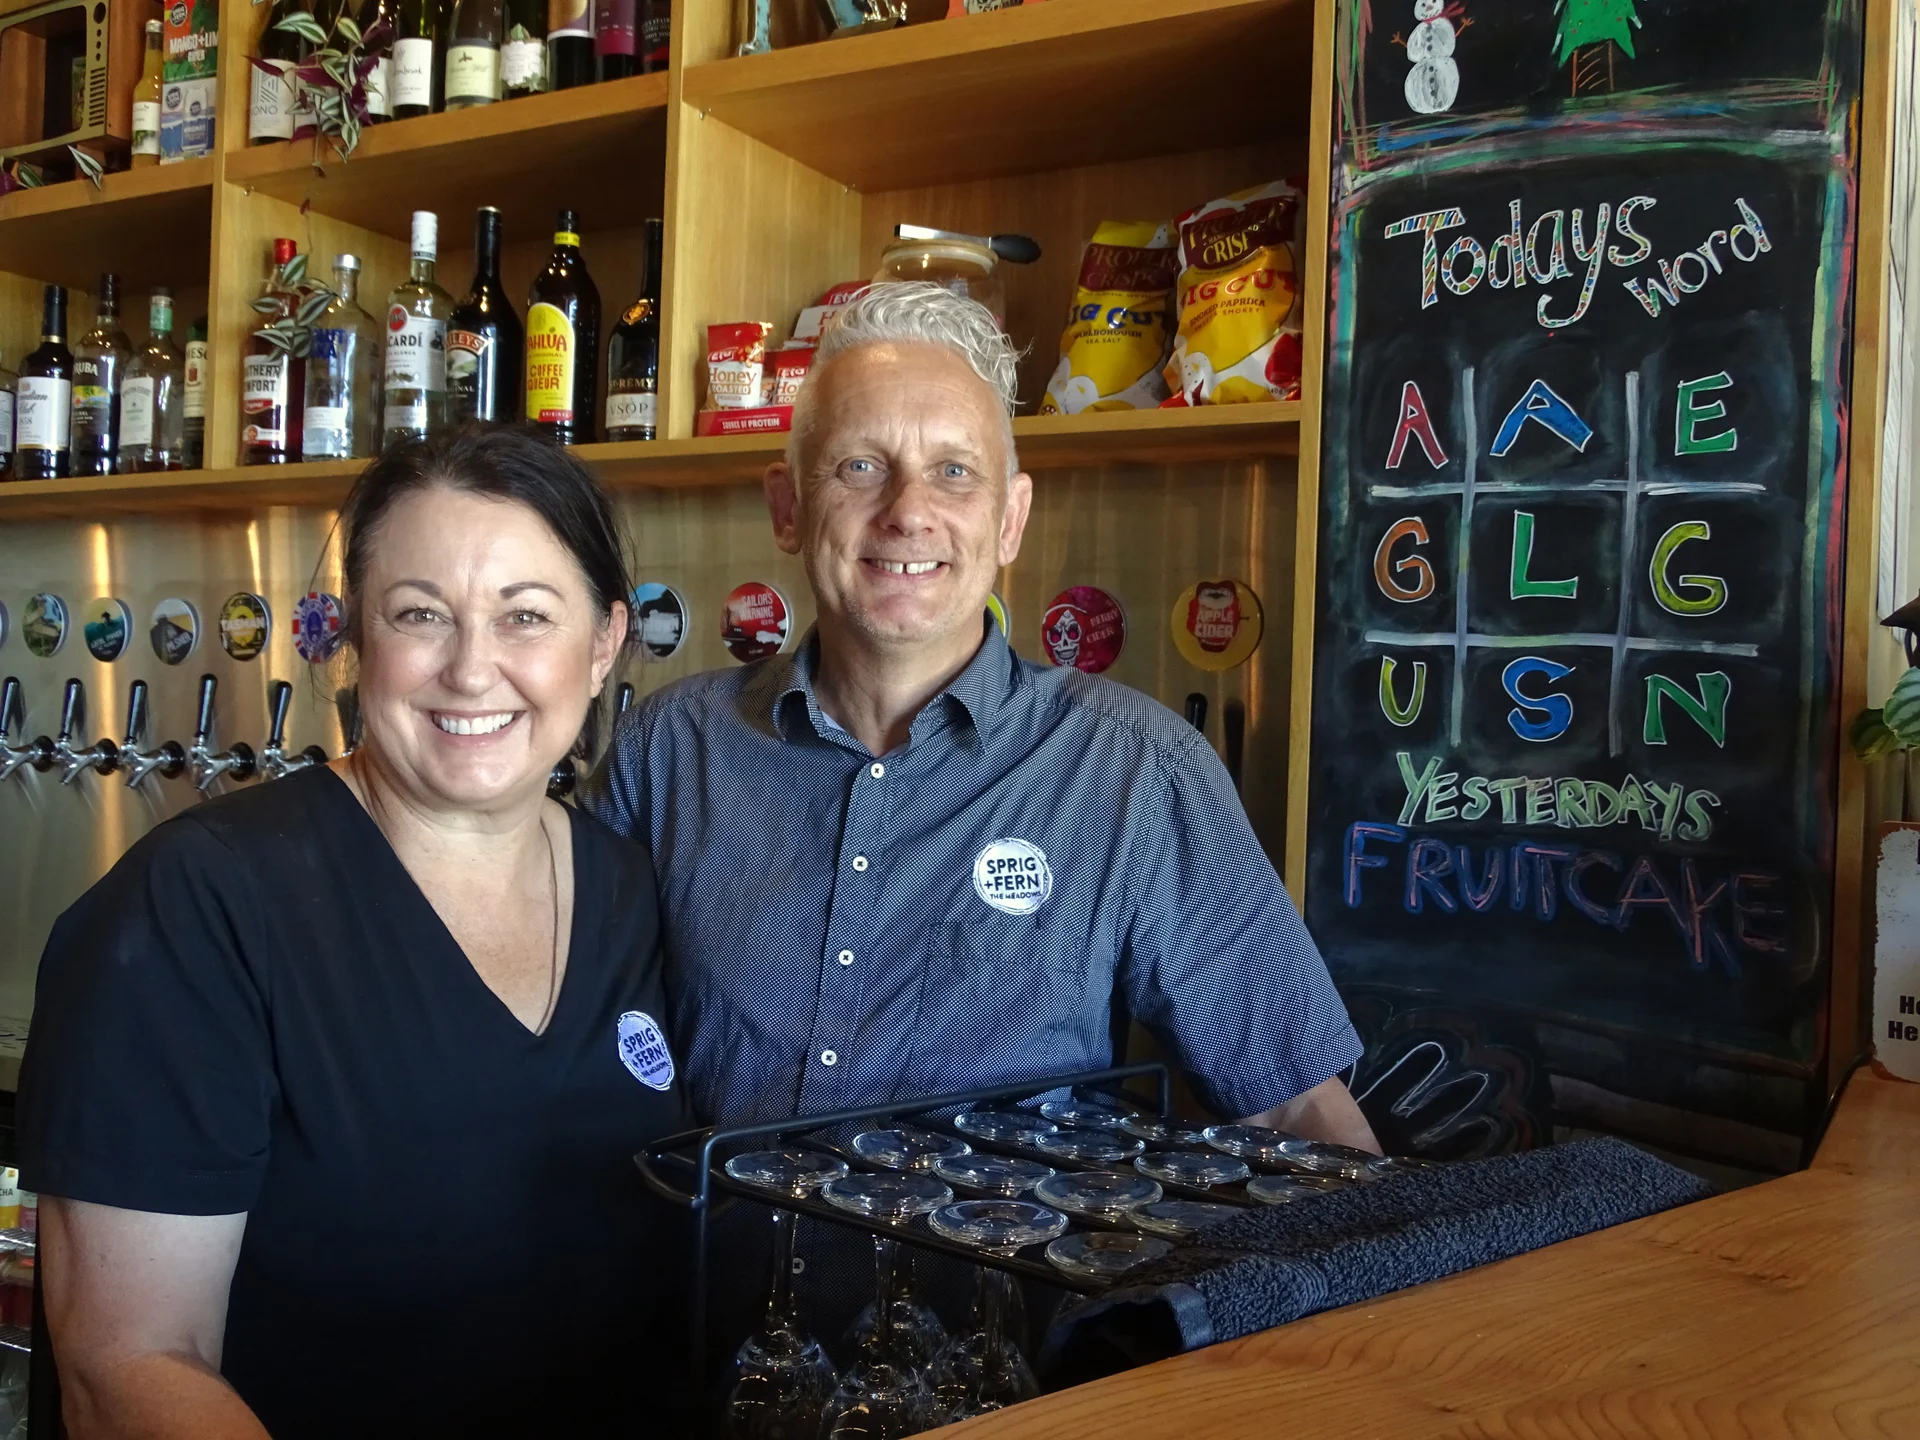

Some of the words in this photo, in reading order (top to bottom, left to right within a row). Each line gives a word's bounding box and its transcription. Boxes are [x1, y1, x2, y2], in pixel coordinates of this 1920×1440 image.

[1384, 195, 1657, 329] Todays
[1220, 297, 1266, 309] PAPRIKA
[530, 364, 564, 378] COFFEE
[709, 367, 758, 386] Honey
[711, 385, 750, 395] ROASTED
[748, 417, 781, 428] PROTEIN
[1385, 380, 1449, 470] A
[1674, 370, 1738, 457] E
[1373, 516, 1436, 604] G
[1510, 510, 1579, 600] L
[1648, 520, 1729, 618] G
[741, 593, 773, 607] SAILORS
[1090, 607, 1119, 627] BERRY
[1086, 626, 1115, 644] CIDER
[1195, 622, 1235, 638] CIDER
[1378, 654, 1427, 728] U
[1501, 655, 1577, 743] S
[1643, 670, 1732, 749] N
[1395, 752, 1722, 842] YESTERDAYS
[986, 857, 1037, 875] SPRIG
[989, 892, 1004, 900] THE
[1005, 890, 1043, 900] MEADOWS
[1343, 820, 1790, 979] FRUITCAKE
[623, 1027, 657, 1054] SPRIG
[1888, 1020, 1919, 1042] He
